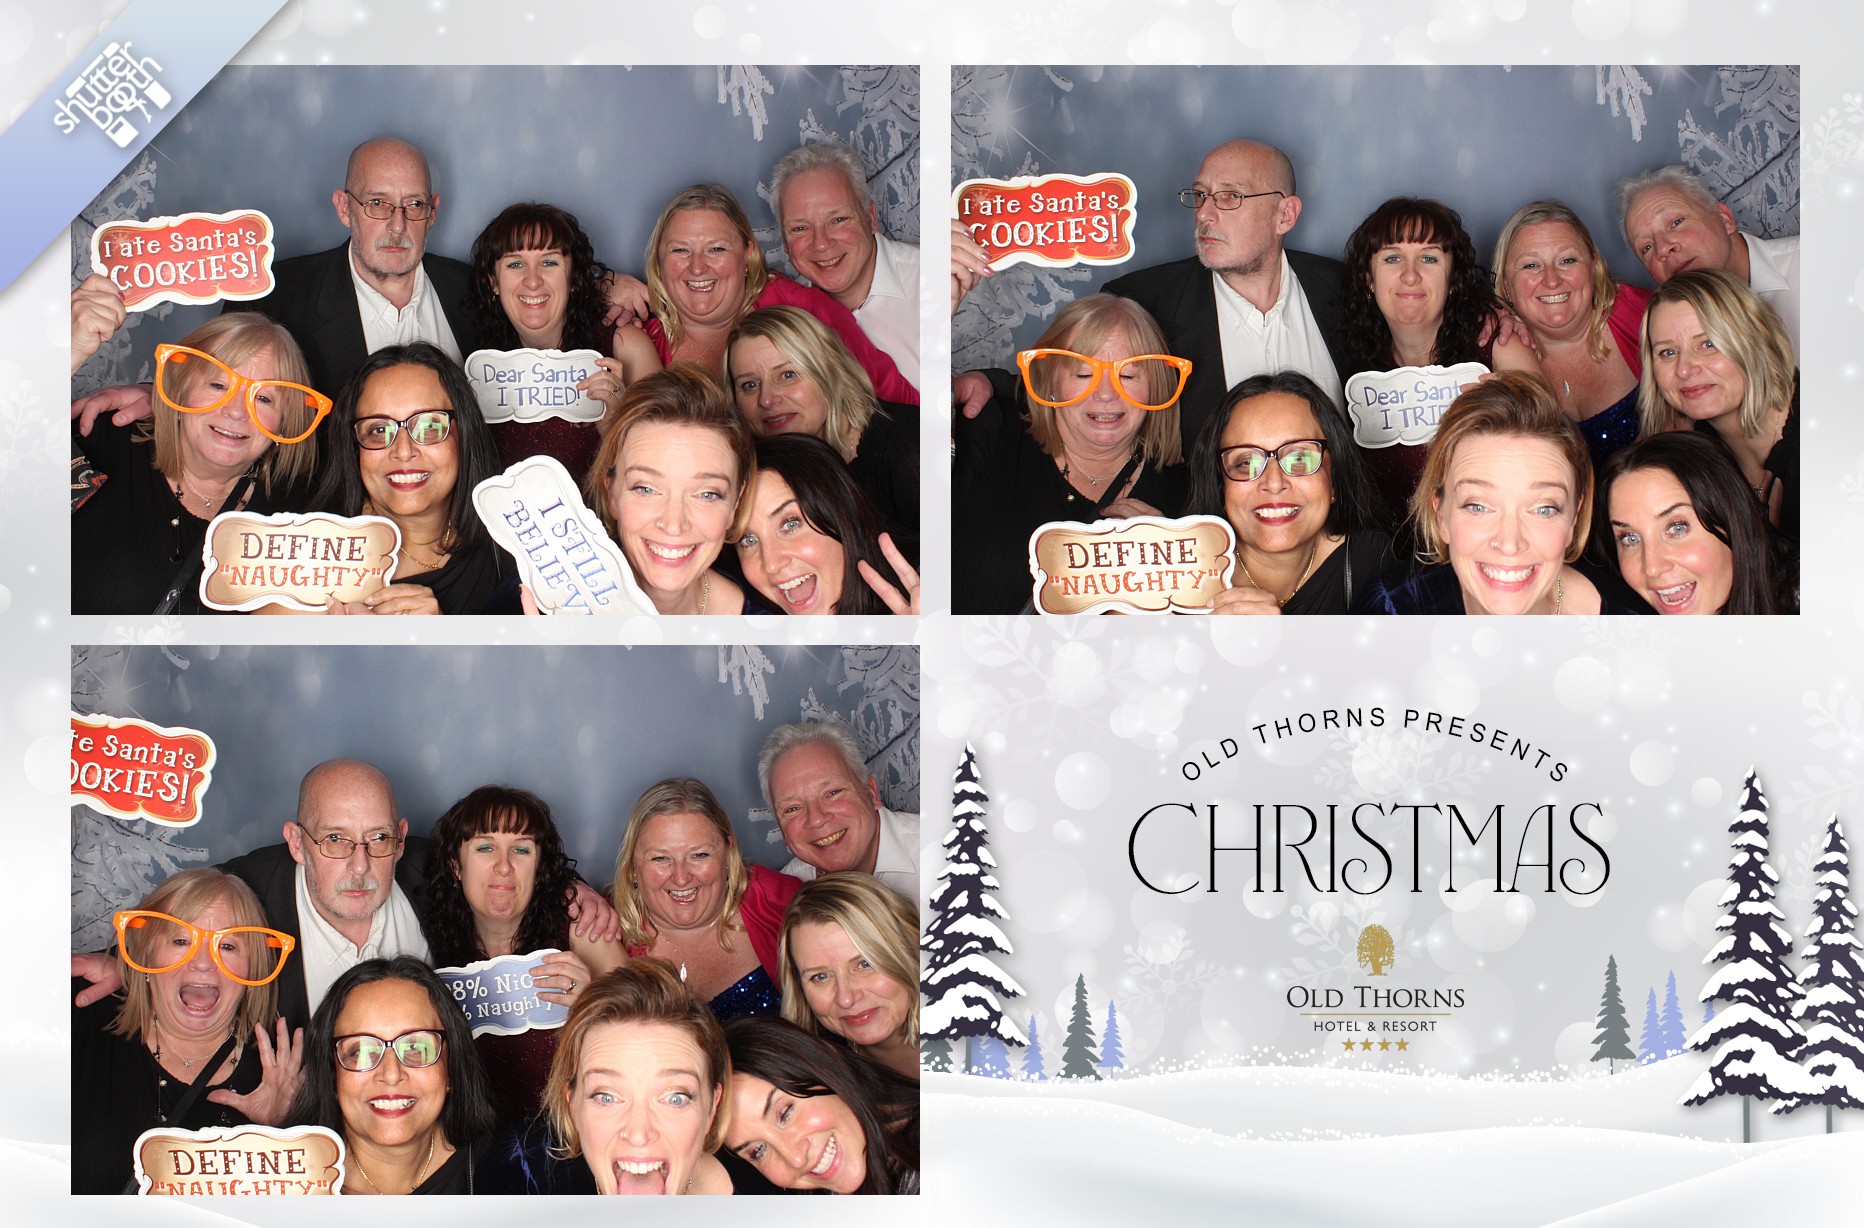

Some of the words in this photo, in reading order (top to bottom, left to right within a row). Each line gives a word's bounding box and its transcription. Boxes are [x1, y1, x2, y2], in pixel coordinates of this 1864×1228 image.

[963, 198, 971, 215] I
[979, 195, 1021, 216] ate
[1029, 191, 1119, 213] Santa's
[104, 241, 112, 258] I
[120, 236, 161, 259] ate
[169, 228, 257, 252] Santa's
[969, 213, 1119, 248] COOKIES!
[110, 249, 259, 291] COOKIES!
[483, 364, 525, 385] Dear
[531, 363, 588, 383] Santa
[497, 387, 507, 407] I
[514, 386, 581, 407] TRIED!
[1364, 386, 1408, 407] Dear
[1413, 380, 1461, 402] Sant
[1380, 408, 1393, 430] I
[538, 497, 565, 518] I
[240, 532, 367, 562] DEFINE
[503, 499, 594, 616] BELIEV
[1063, 537, 1198, 569] DEFINE
[219, 564, 381, 588] "NAUGHTY"
[551, 518, 618, 606] STILL
[1049, 568, 1219, 596] "NAUGHTY"
[71, 729, 94, 752] te
[101, 734, 197, 769] Santa's
[71, 759, 190, 805] OKIES!
[445, 976, 488, 1001] 8%
[168, 1148, 306, 1176] DEFINE
